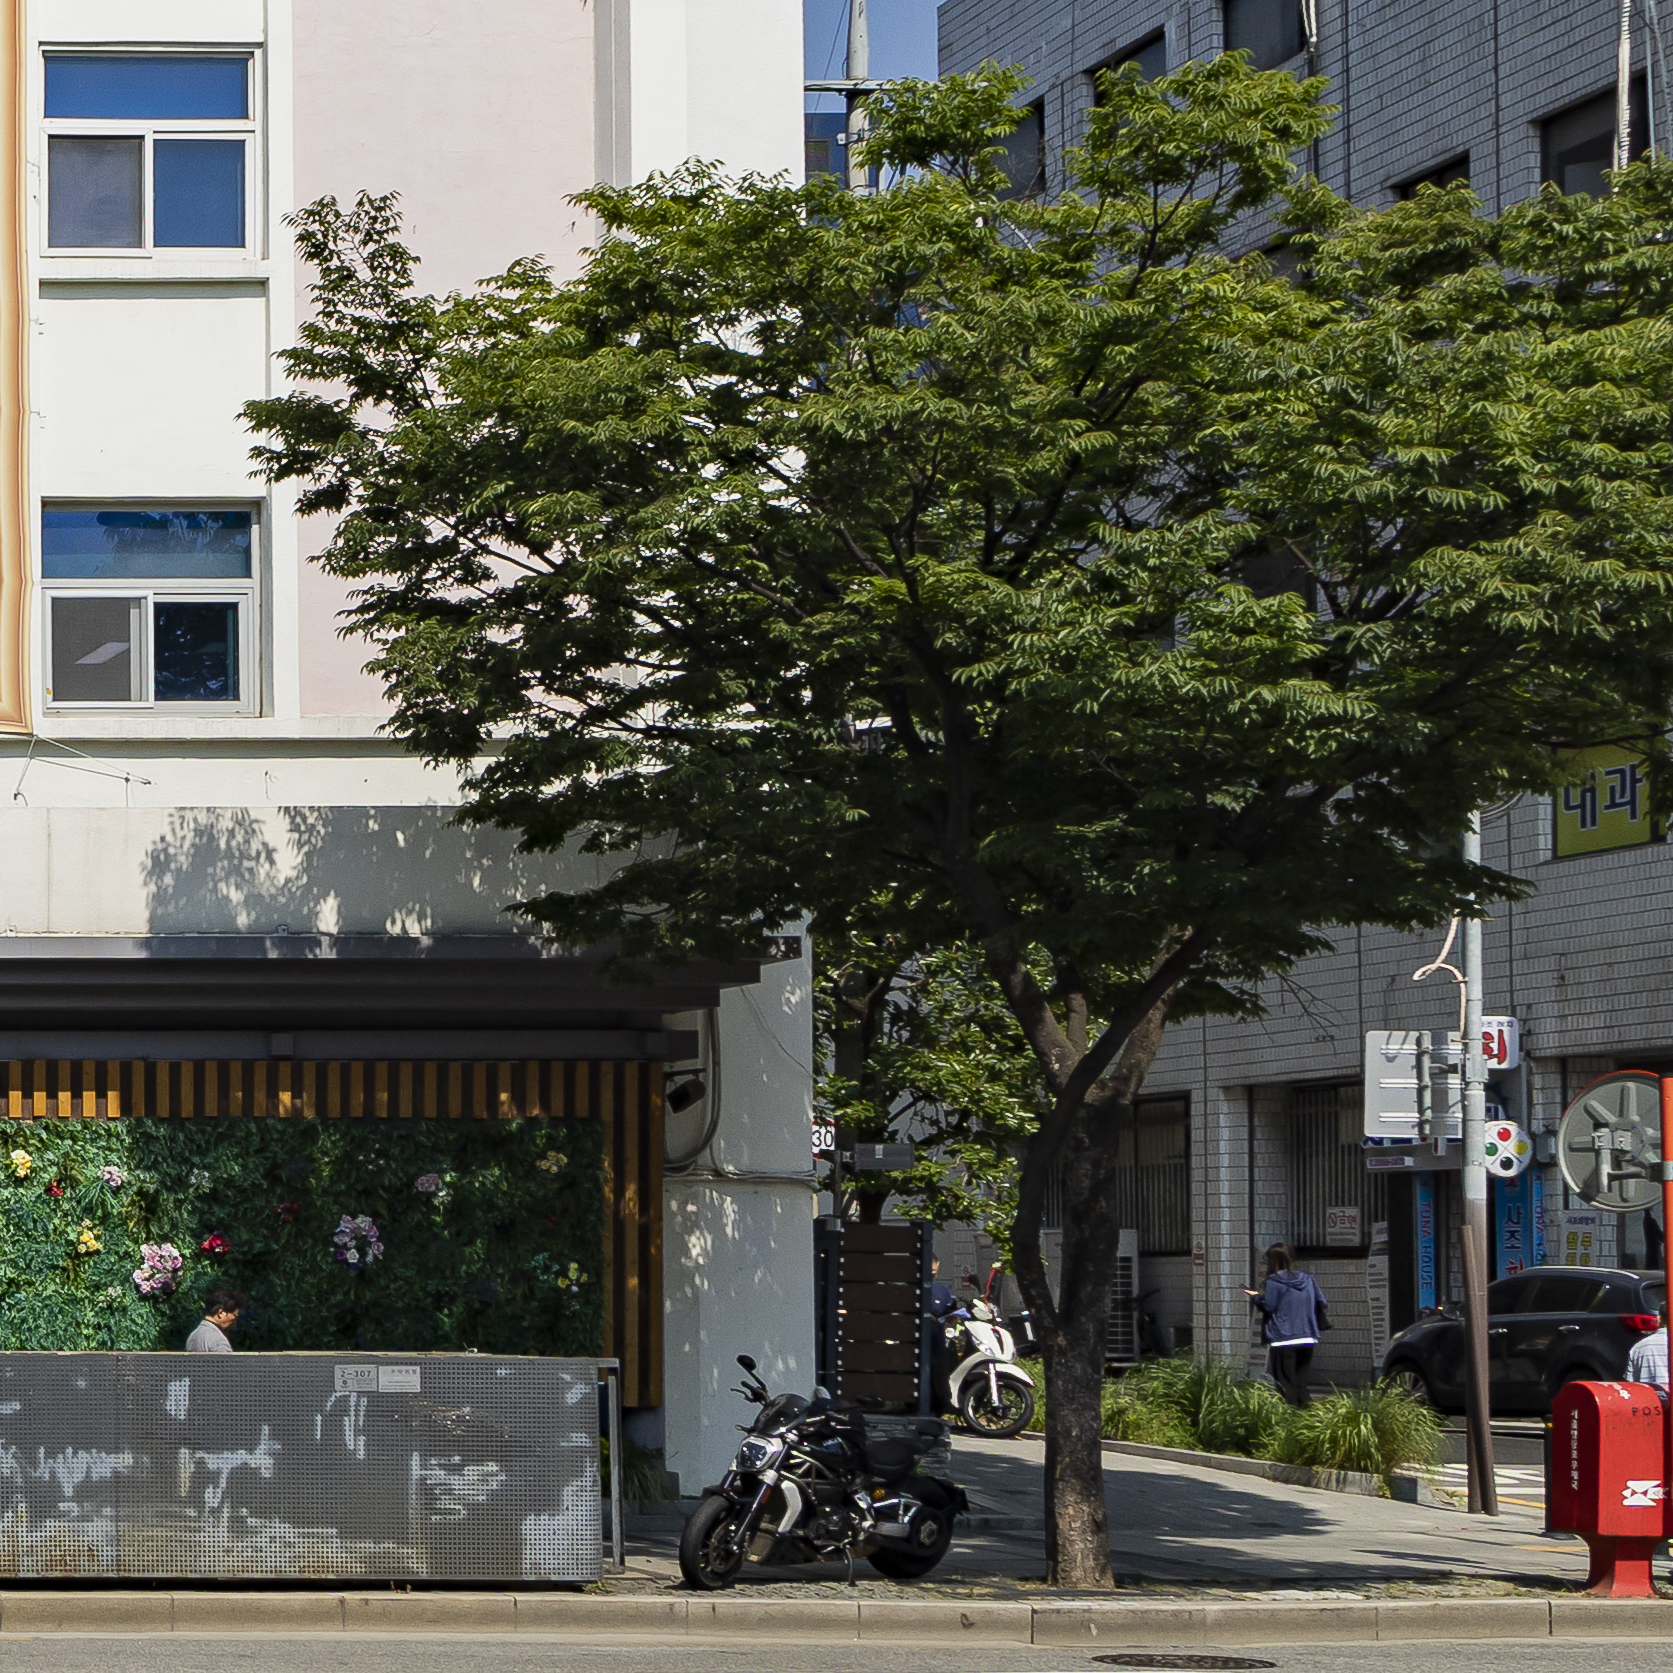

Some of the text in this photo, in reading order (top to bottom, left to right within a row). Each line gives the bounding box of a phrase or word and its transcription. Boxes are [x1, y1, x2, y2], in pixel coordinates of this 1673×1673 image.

[1562, 762, 1646, 832] 내과
[812, 1130, 834, 1147] 30
[1421, 1244, 1432, 1290] HOUSE
[340, 1370, 372, 1378] 2-307
